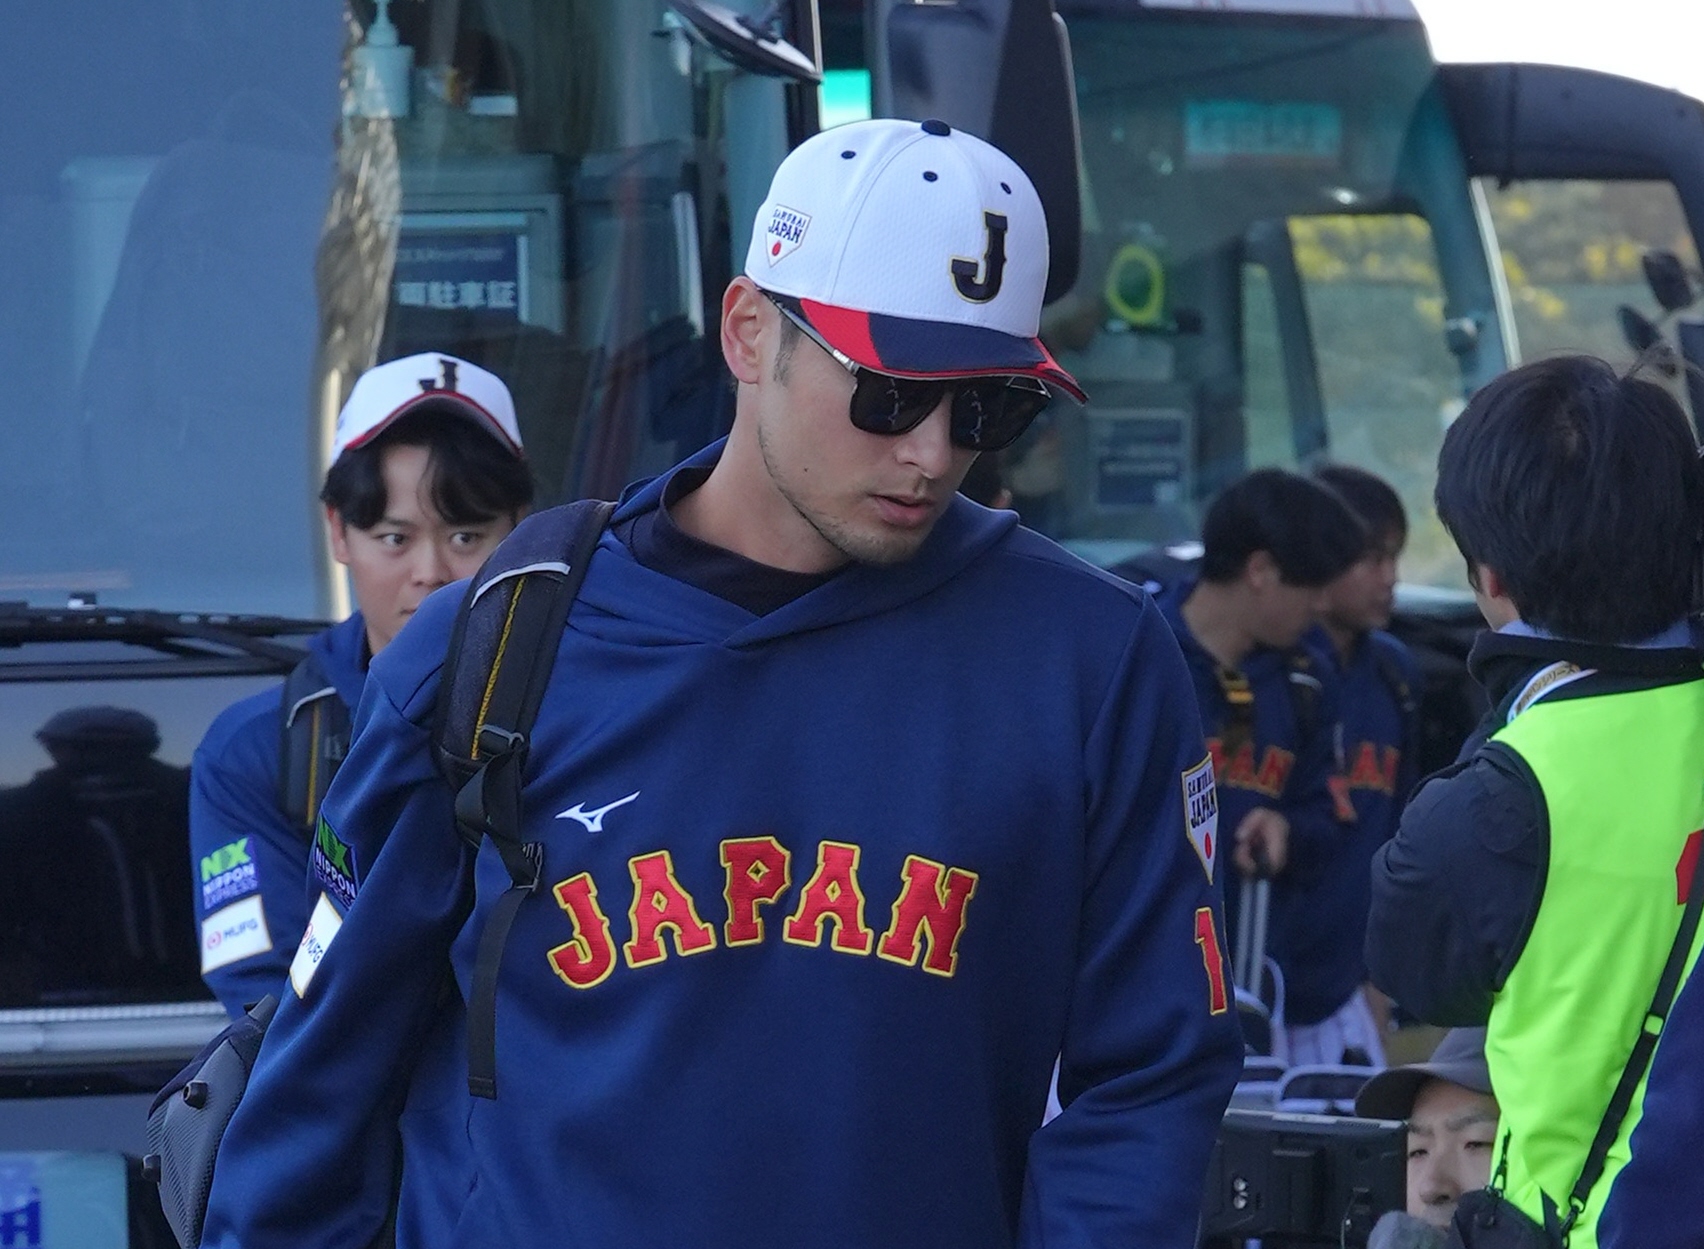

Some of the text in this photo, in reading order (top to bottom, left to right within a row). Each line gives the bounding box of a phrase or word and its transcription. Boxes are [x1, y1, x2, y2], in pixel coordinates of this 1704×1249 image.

[768, 218, 803, 244] JAPAN
[949, 208, 1008, 304] J
[418, 358, 458, 394] J
[203, 862, 255, 896] NIPPON
[315, 847, 357, 899] NIPPON
[546, 836, 979, 989] JAPAN
[1195, 906, 1228, 1016] 1
